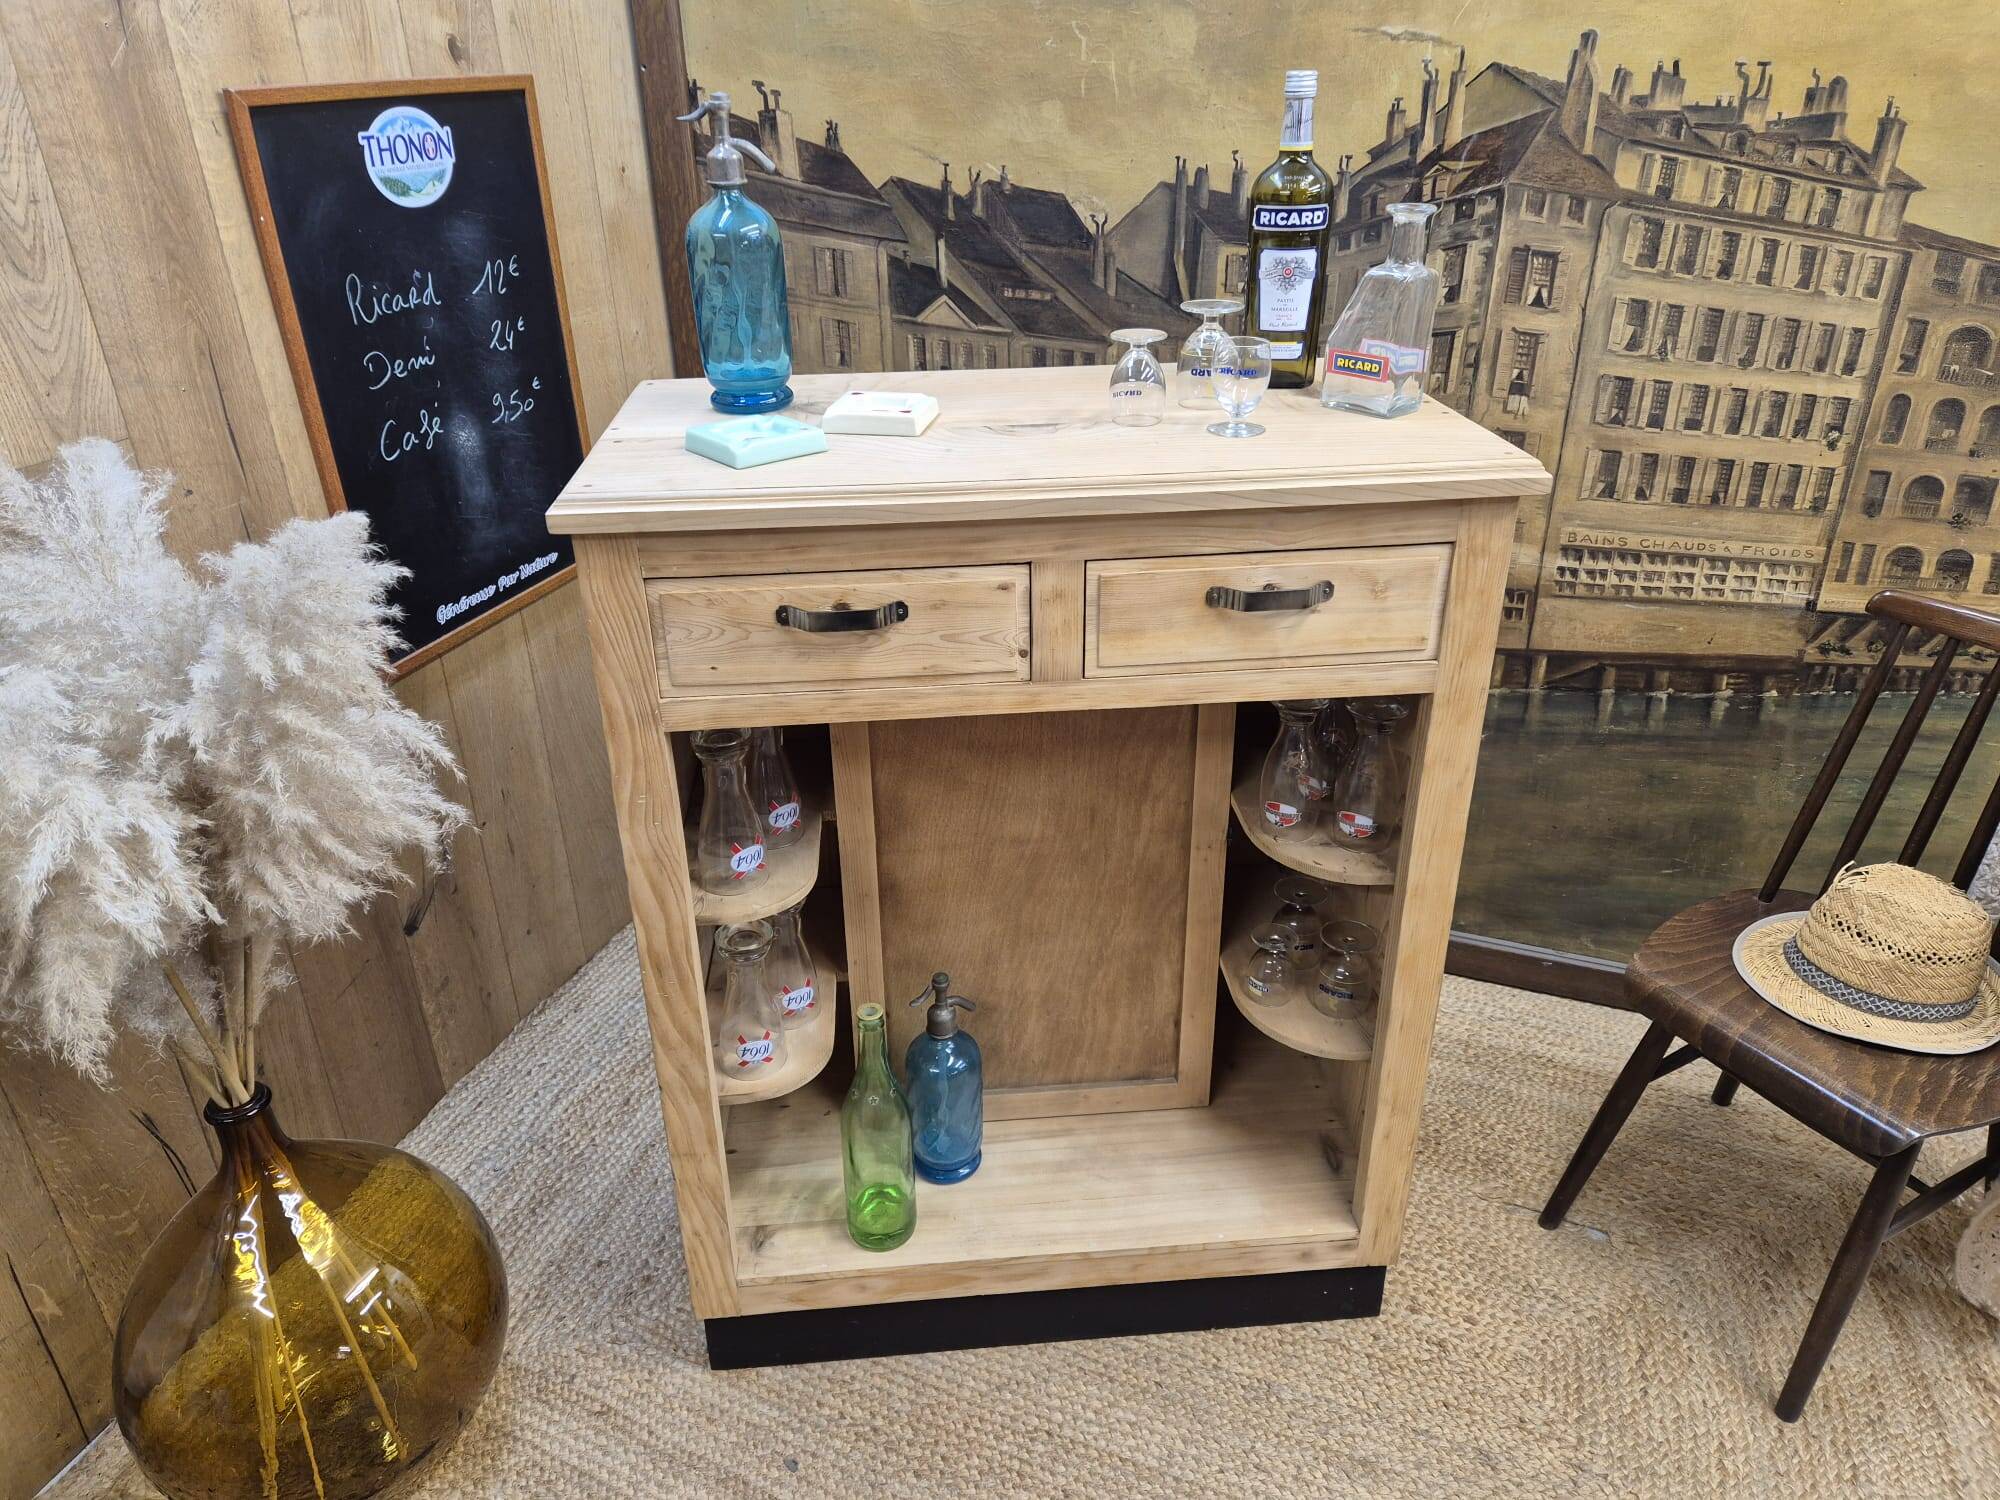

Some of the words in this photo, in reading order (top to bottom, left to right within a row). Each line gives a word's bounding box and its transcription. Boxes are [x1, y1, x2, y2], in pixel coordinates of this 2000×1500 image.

[361, 131, 453, 167] THONON
[1260, 210, 1325, 226] RICARD
[346, 272, 441, 326] Ricard
[472, 254, 520, 295] 12€
[363, 346, 435, 390] Demi
[489, 315, 526, 350] 24€
[1336, 357, 1380, 373] RICARD
[380, 401, 444, 461] Café
[492, 376, 541, 424] 9,50€
[1567, 531, 1628, 547] BAINS
[1639, 538, 1716, 552] CHAUDS
[1741, 545, 1815, 558] FROIDS
[740, 1043, 770, 1059] 1664
